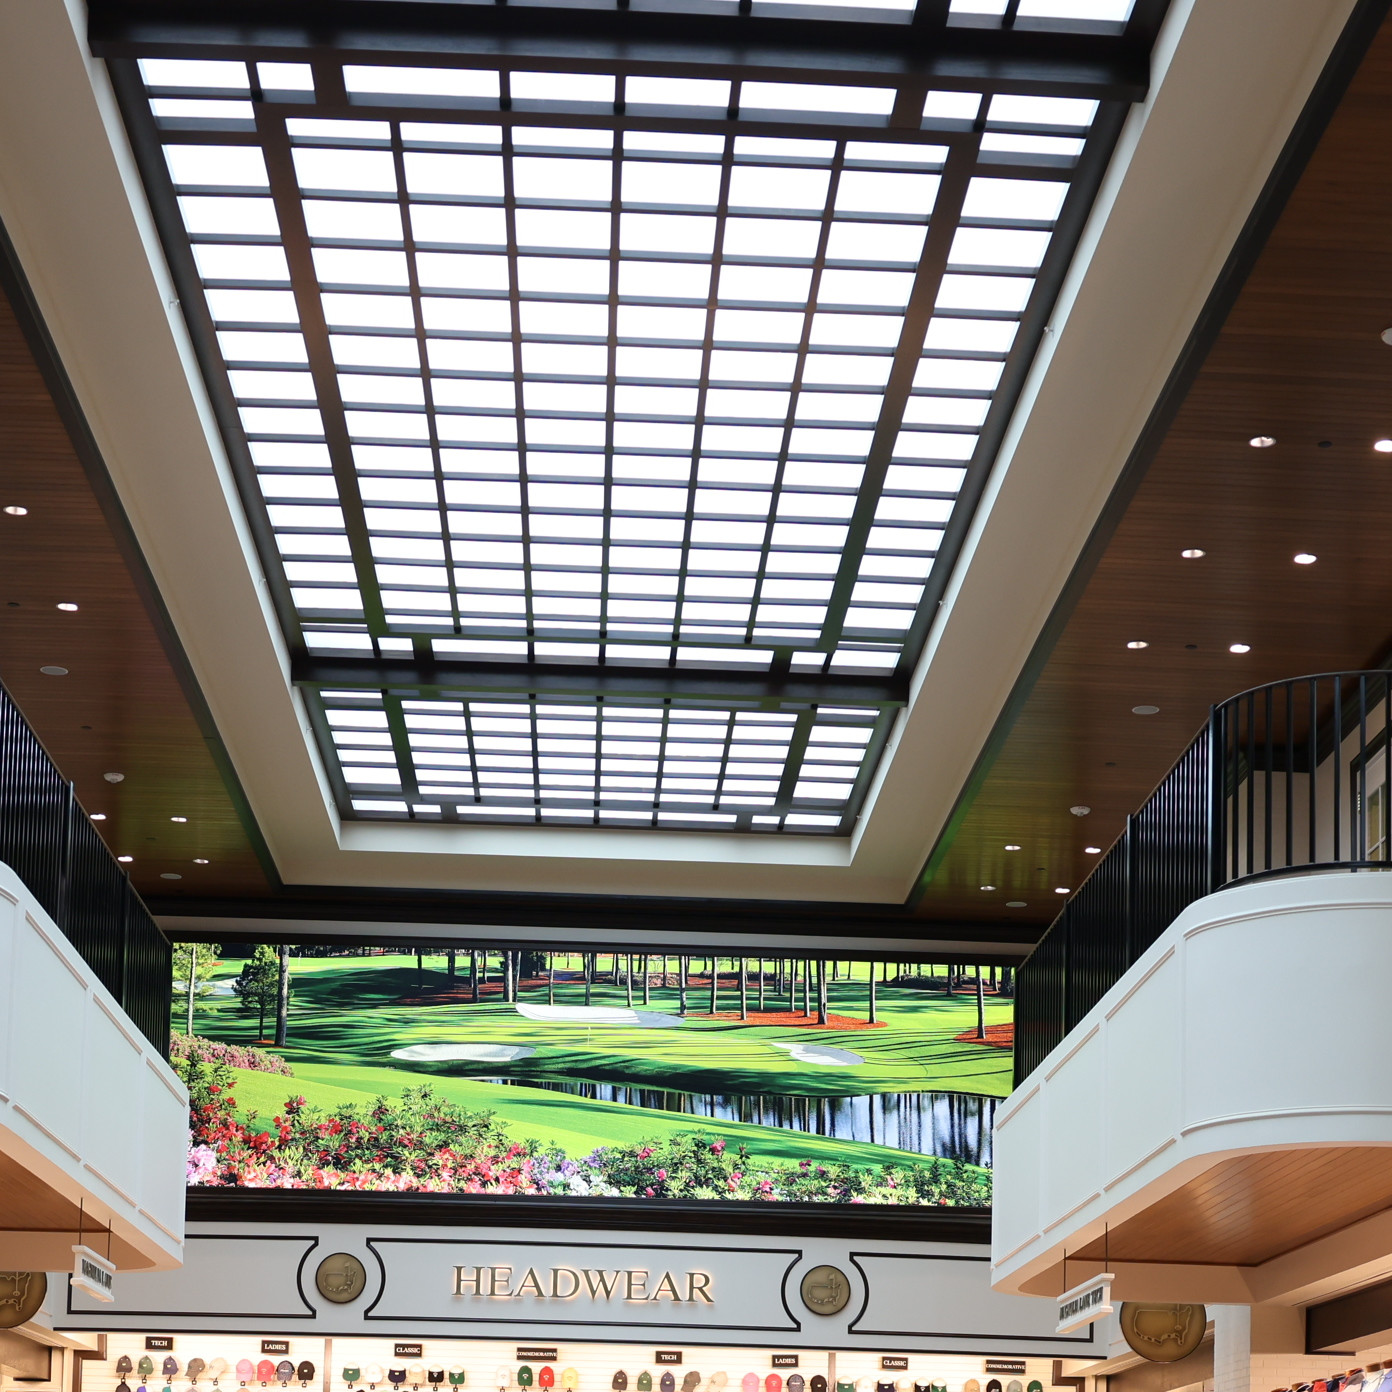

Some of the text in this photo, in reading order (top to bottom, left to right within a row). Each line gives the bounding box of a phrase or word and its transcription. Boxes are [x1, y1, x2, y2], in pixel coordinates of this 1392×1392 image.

[451, 1265, 715, 1304] HEADWEAR
[264, 1343, 286, 1351] LADIES
[396, 1346, 421, 1354] CLASSIC
[883, 1359, 907, 1367] CLASSIC
